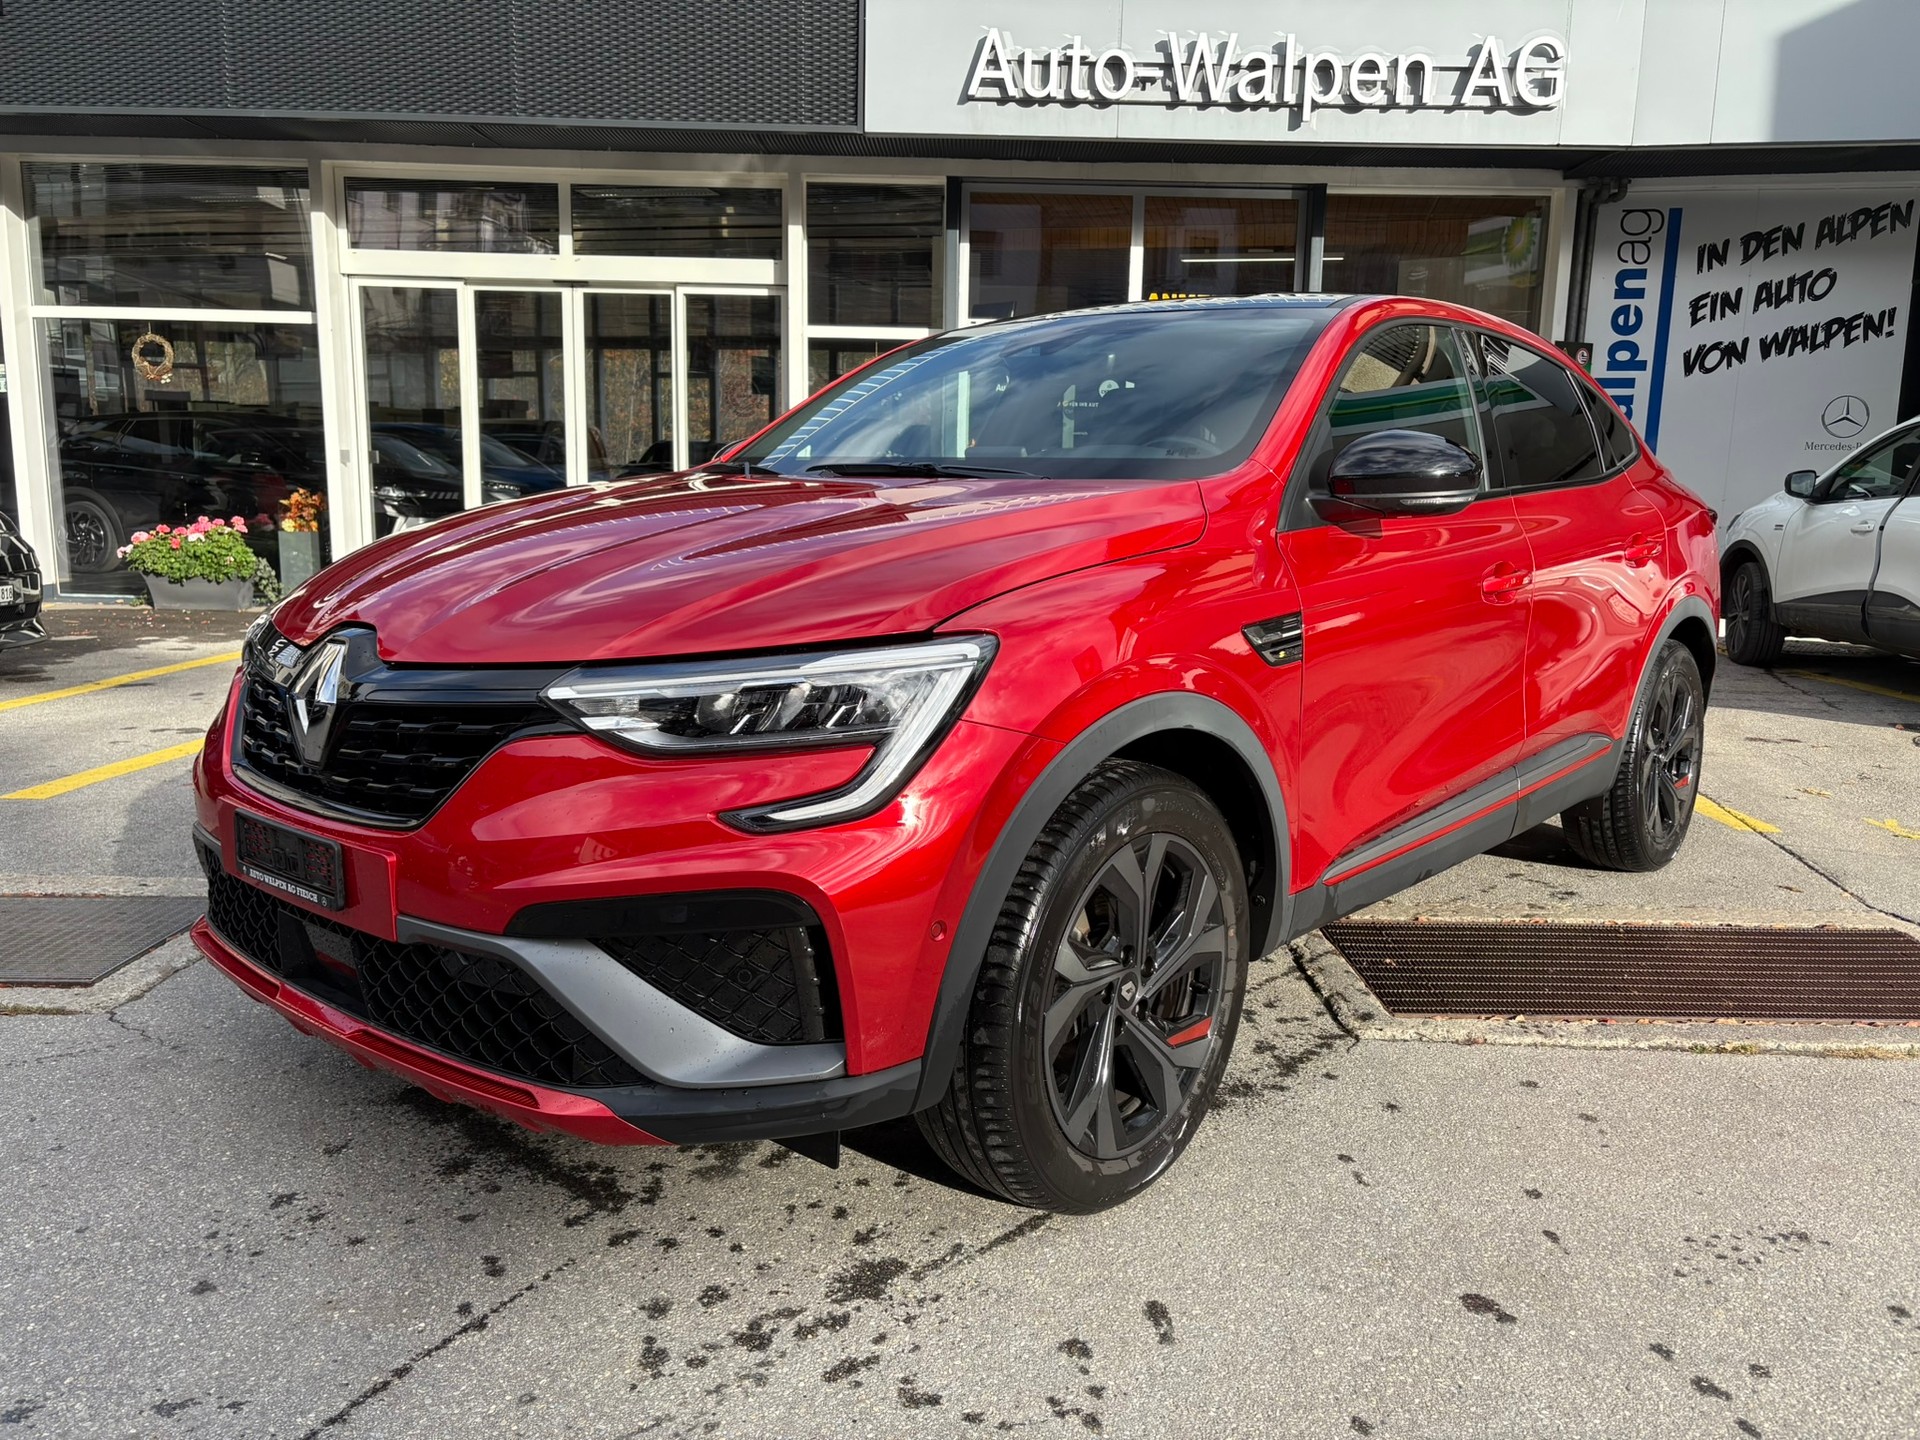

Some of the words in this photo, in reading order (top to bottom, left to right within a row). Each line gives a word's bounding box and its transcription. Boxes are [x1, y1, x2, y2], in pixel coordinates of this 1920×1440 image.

[967, 27, 1432, 121] Auto-Walpen
[1461, 35, 1567, 107] AG
[1697, 238, 1730, 274] IN
[1740, 222, 1805, 266] DEN
[1814, 199, 1914, 250] ALPEN
[1688, 287, 1743, 328] EIN
[1752, 267, 1838, 315] AUTO
[1683, 336, 1749, 377] VON
[1759, 306, 1897, 363] WALPEN!
